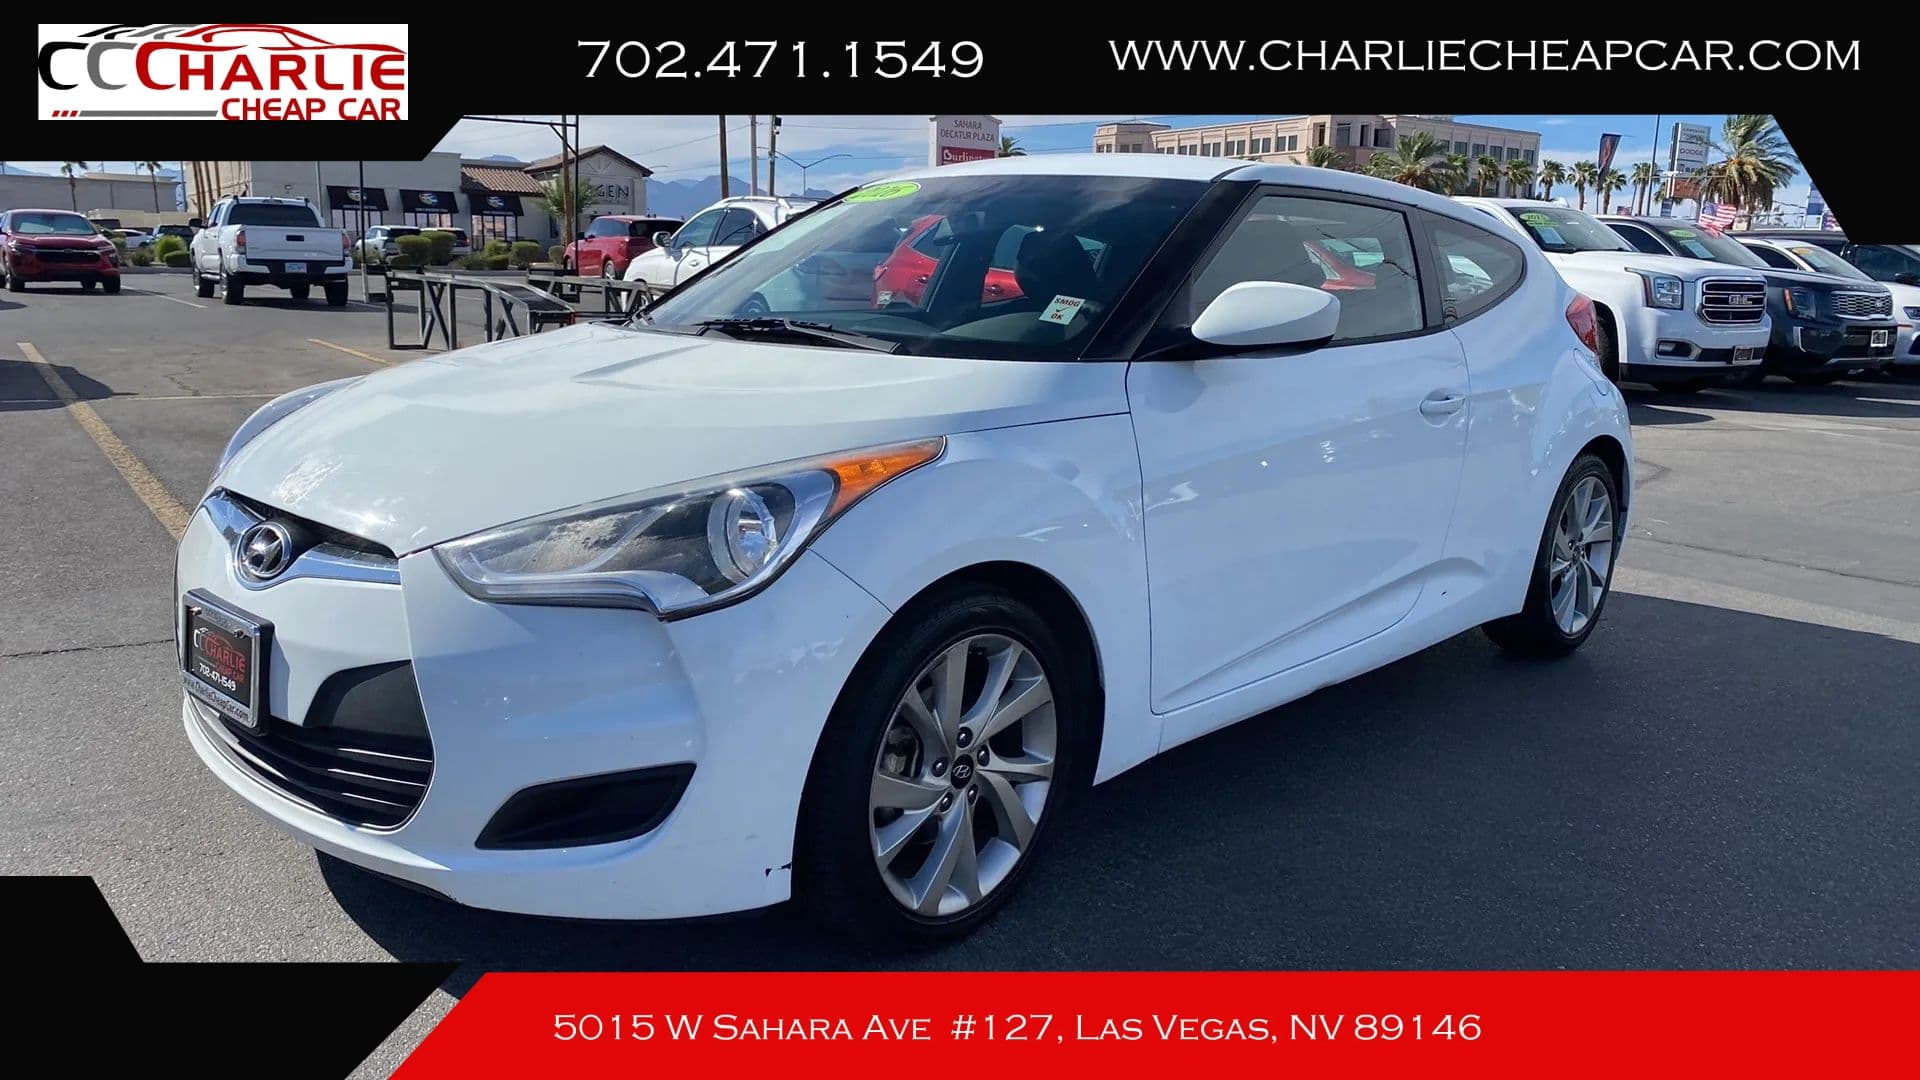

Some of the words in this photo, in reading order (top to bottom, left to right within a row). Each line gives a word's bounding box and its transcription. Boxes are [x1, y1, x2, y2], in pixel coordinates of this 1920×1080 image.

[953, 120, 982, 130] SAHARA
[940, 129, 971, 140] DECATUR
[972, 132, 994, 142] PLAZA
[1054, 298, 1080, 307] SMOG
[1728, 294, 1753, 305] GMC
